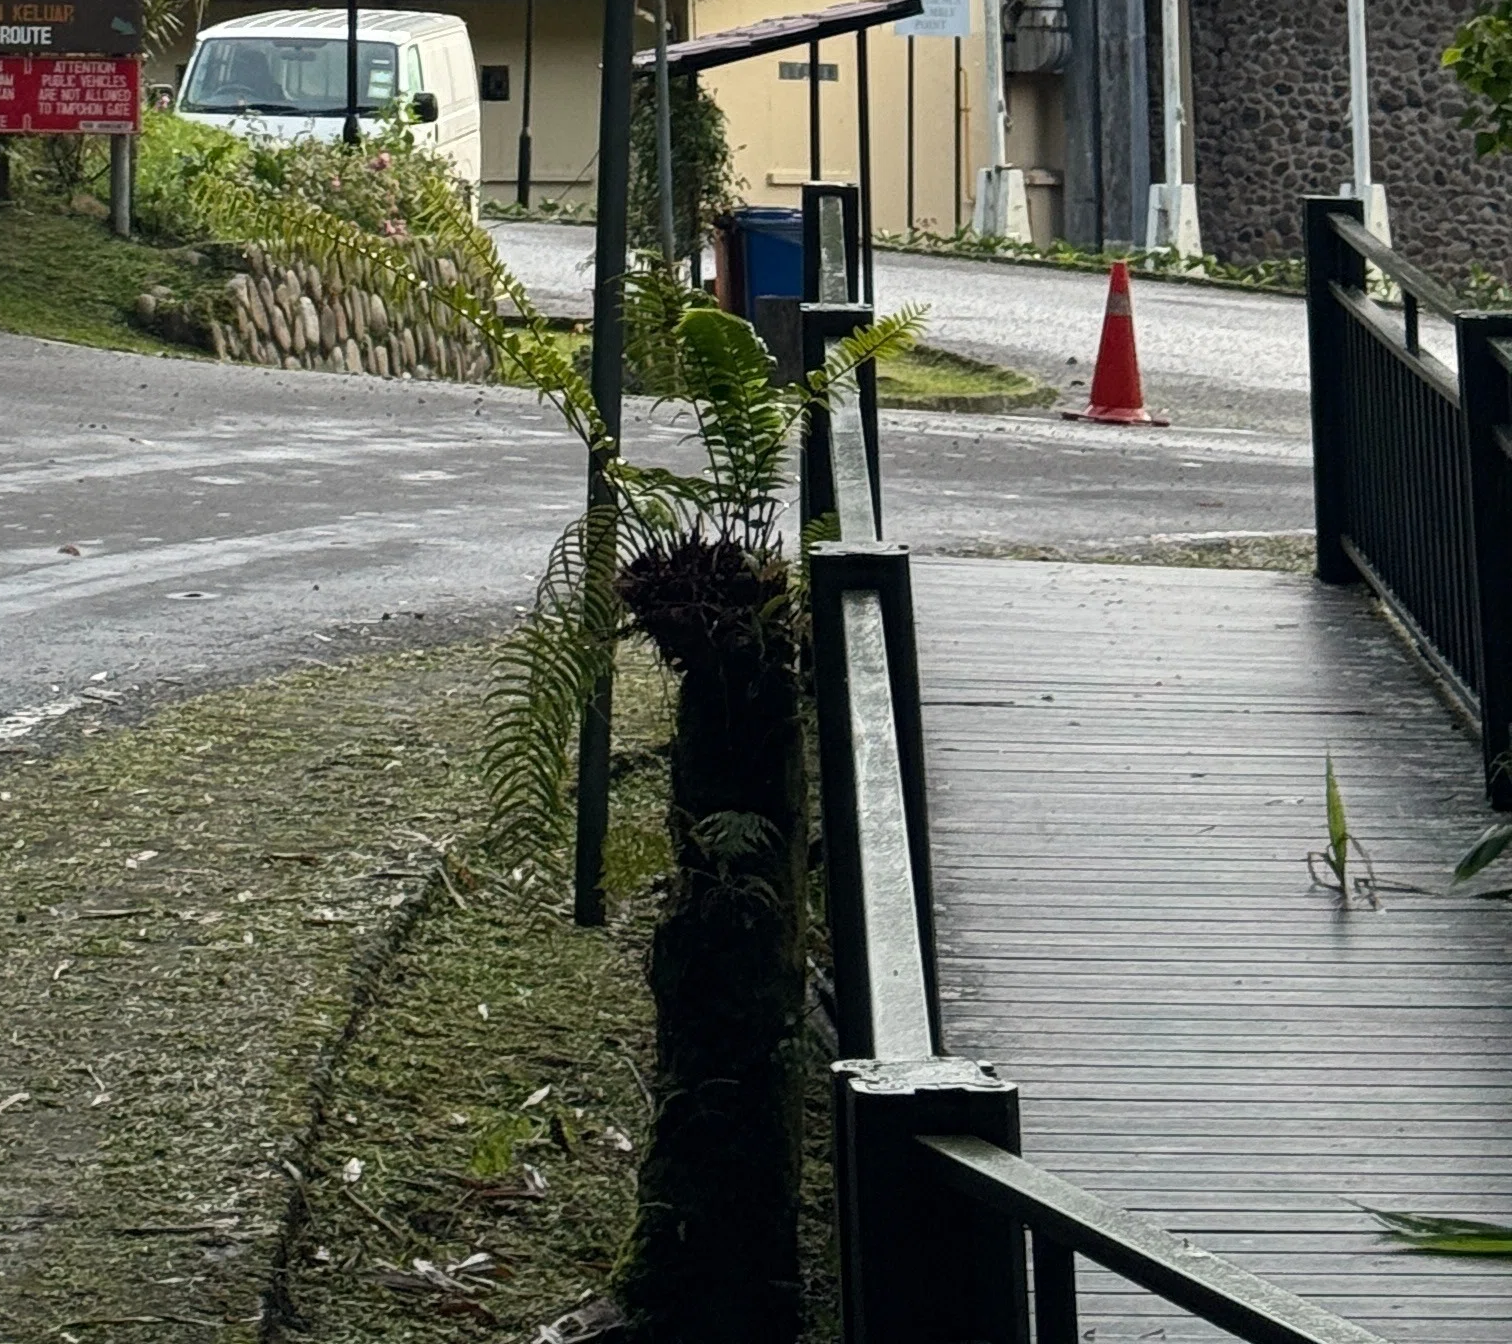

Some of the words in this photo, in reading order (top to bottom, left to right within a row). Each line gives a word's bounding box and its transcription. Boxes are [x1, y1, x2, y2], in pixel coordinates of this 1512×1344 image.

[12, 4, 75, 23] KELUAR
[0, 26, 52, 45] ROUTE
[53, 61, 116, 74] ATTENTION
[41, 74, 76, 87] PUBLIC
[79, 75, 127, 88] VEHICLES
[38, 88, 57, 101] ARE
[60, 88, 81, 101] NOT
[85, 89, 131, 102] ALLOWED
[38, 102, 52, 115] TO
[106, 103, 131, 116] GATE
